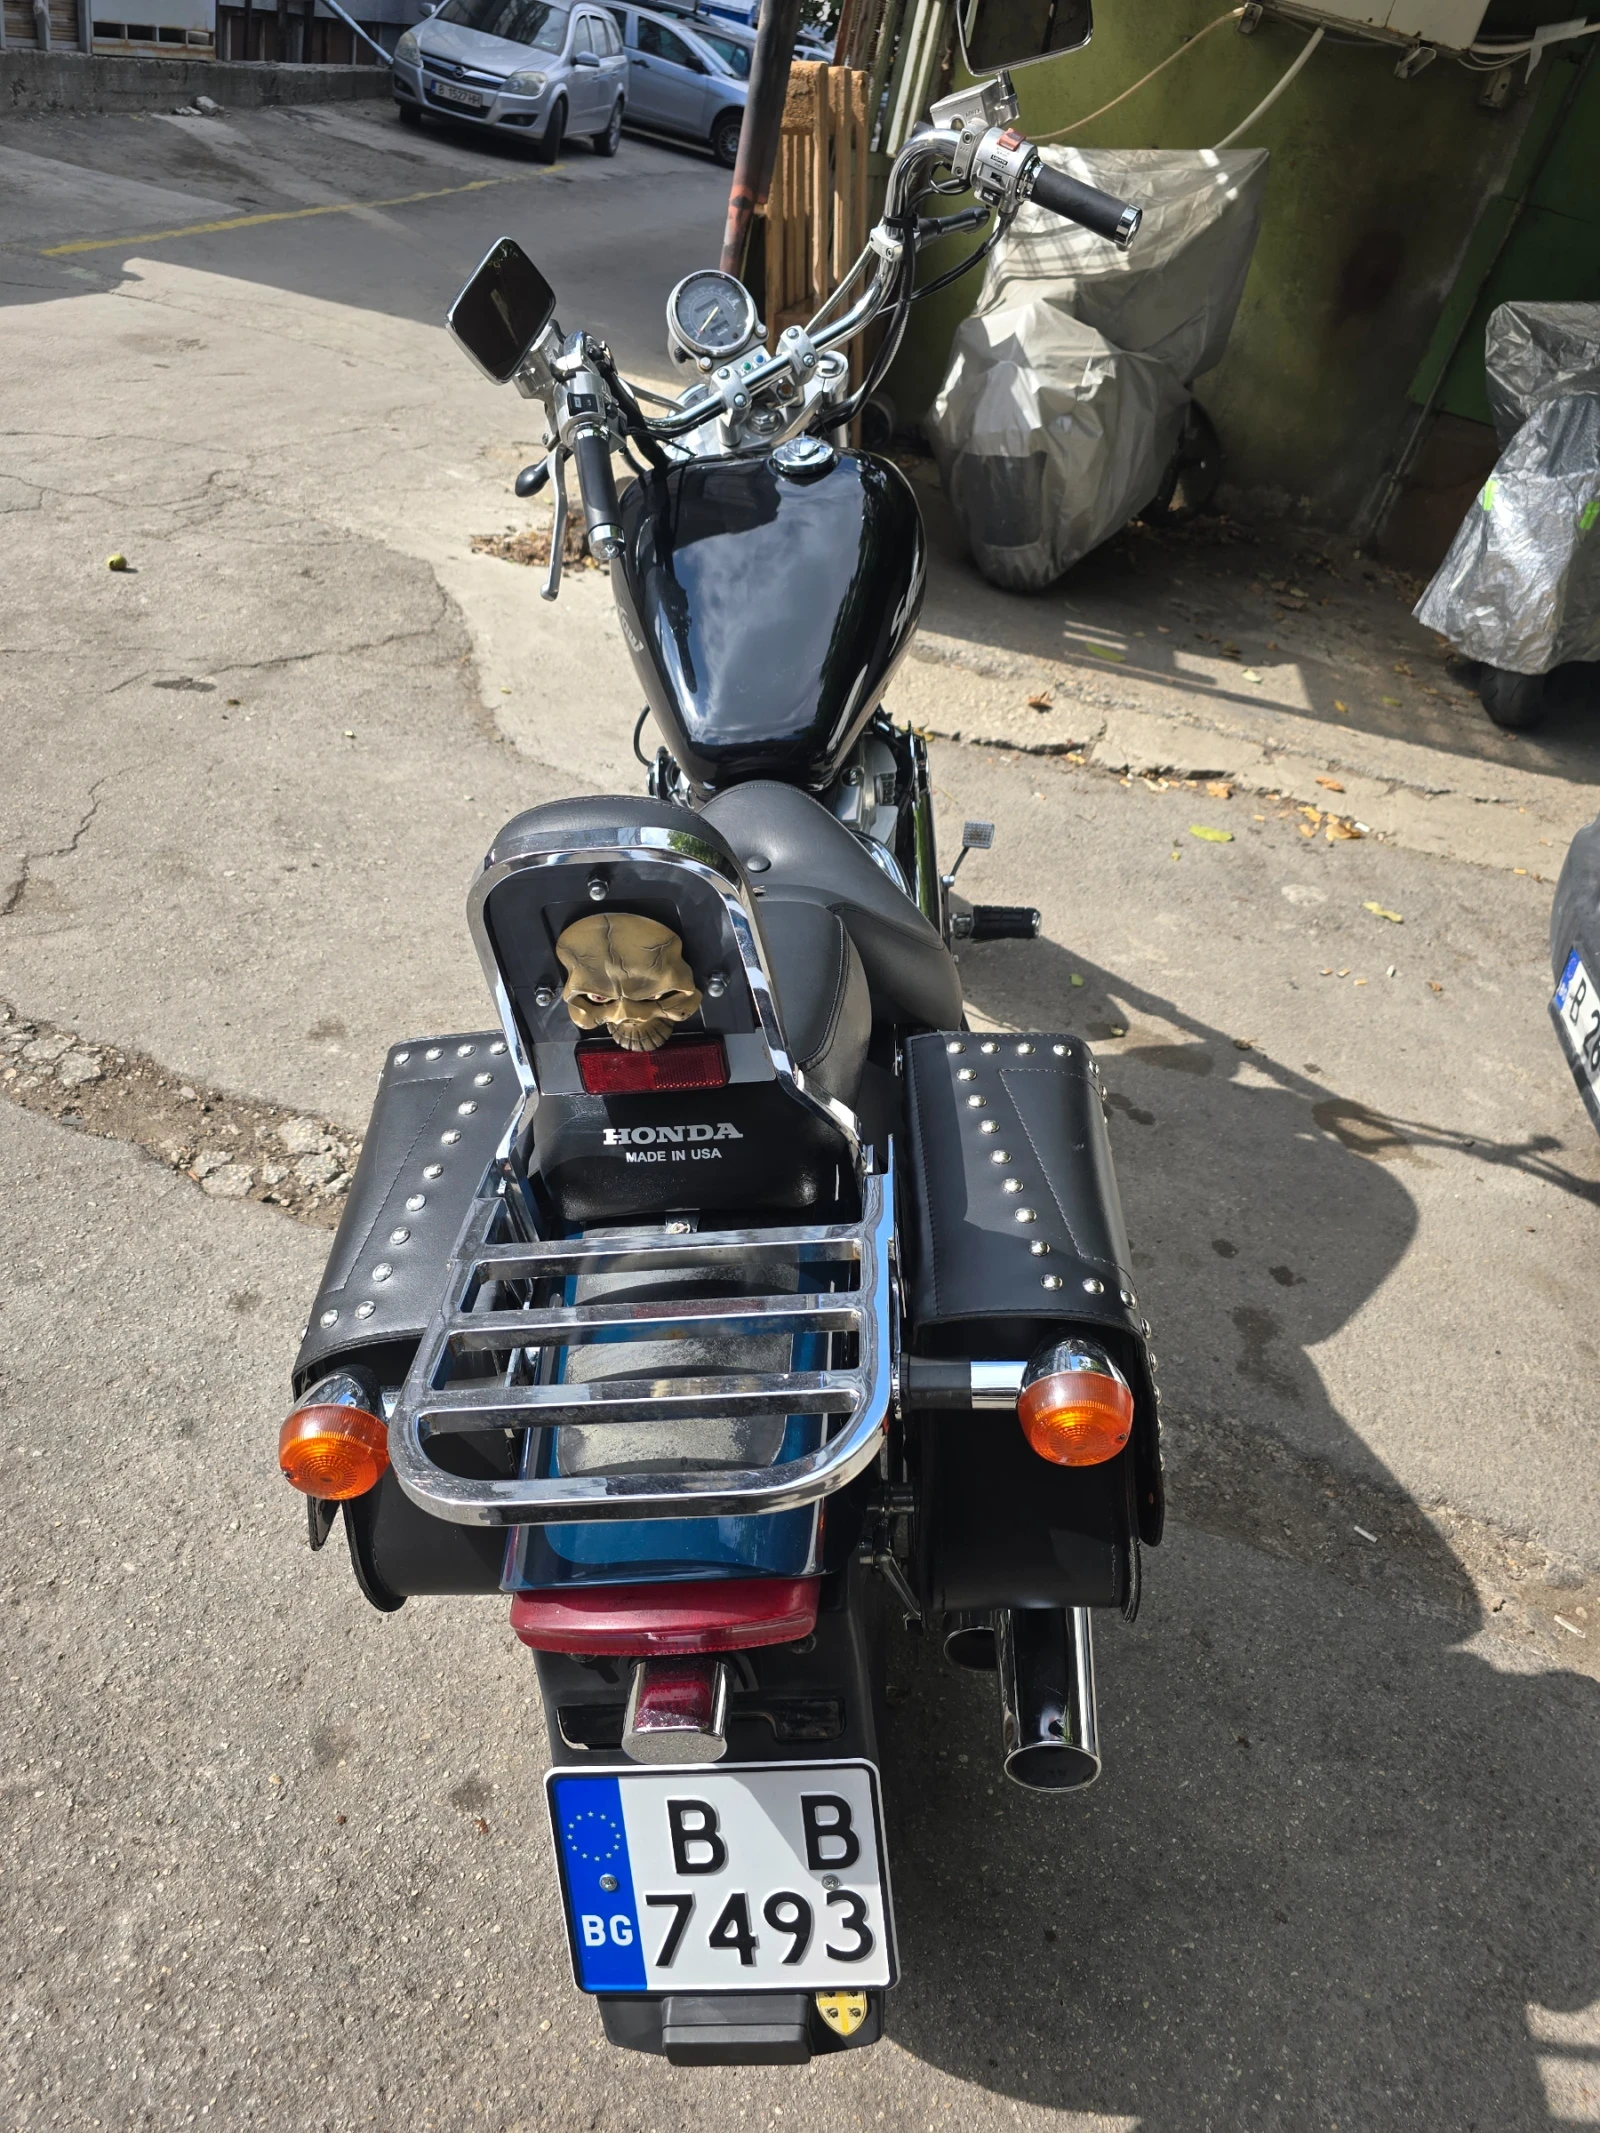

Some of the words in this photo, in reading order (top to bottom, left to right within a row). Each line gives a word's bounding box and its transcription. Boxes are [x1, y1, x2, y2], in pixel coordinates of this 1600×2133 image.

[1570, 977, 1586, 1025] B
[603, 1123, 743, 1145] HONDA
[626, 1151, 667, 1163] MADE
[672, 1150, 686, 1161] IN
[691, 1148, 722, 1160] USA
[666, 1799, 726, 1874] B
[801, 1795, 861, 1870] B
[581, 1915, 633, 1946] BG
[645, 1890, 875, 1967] 7493
